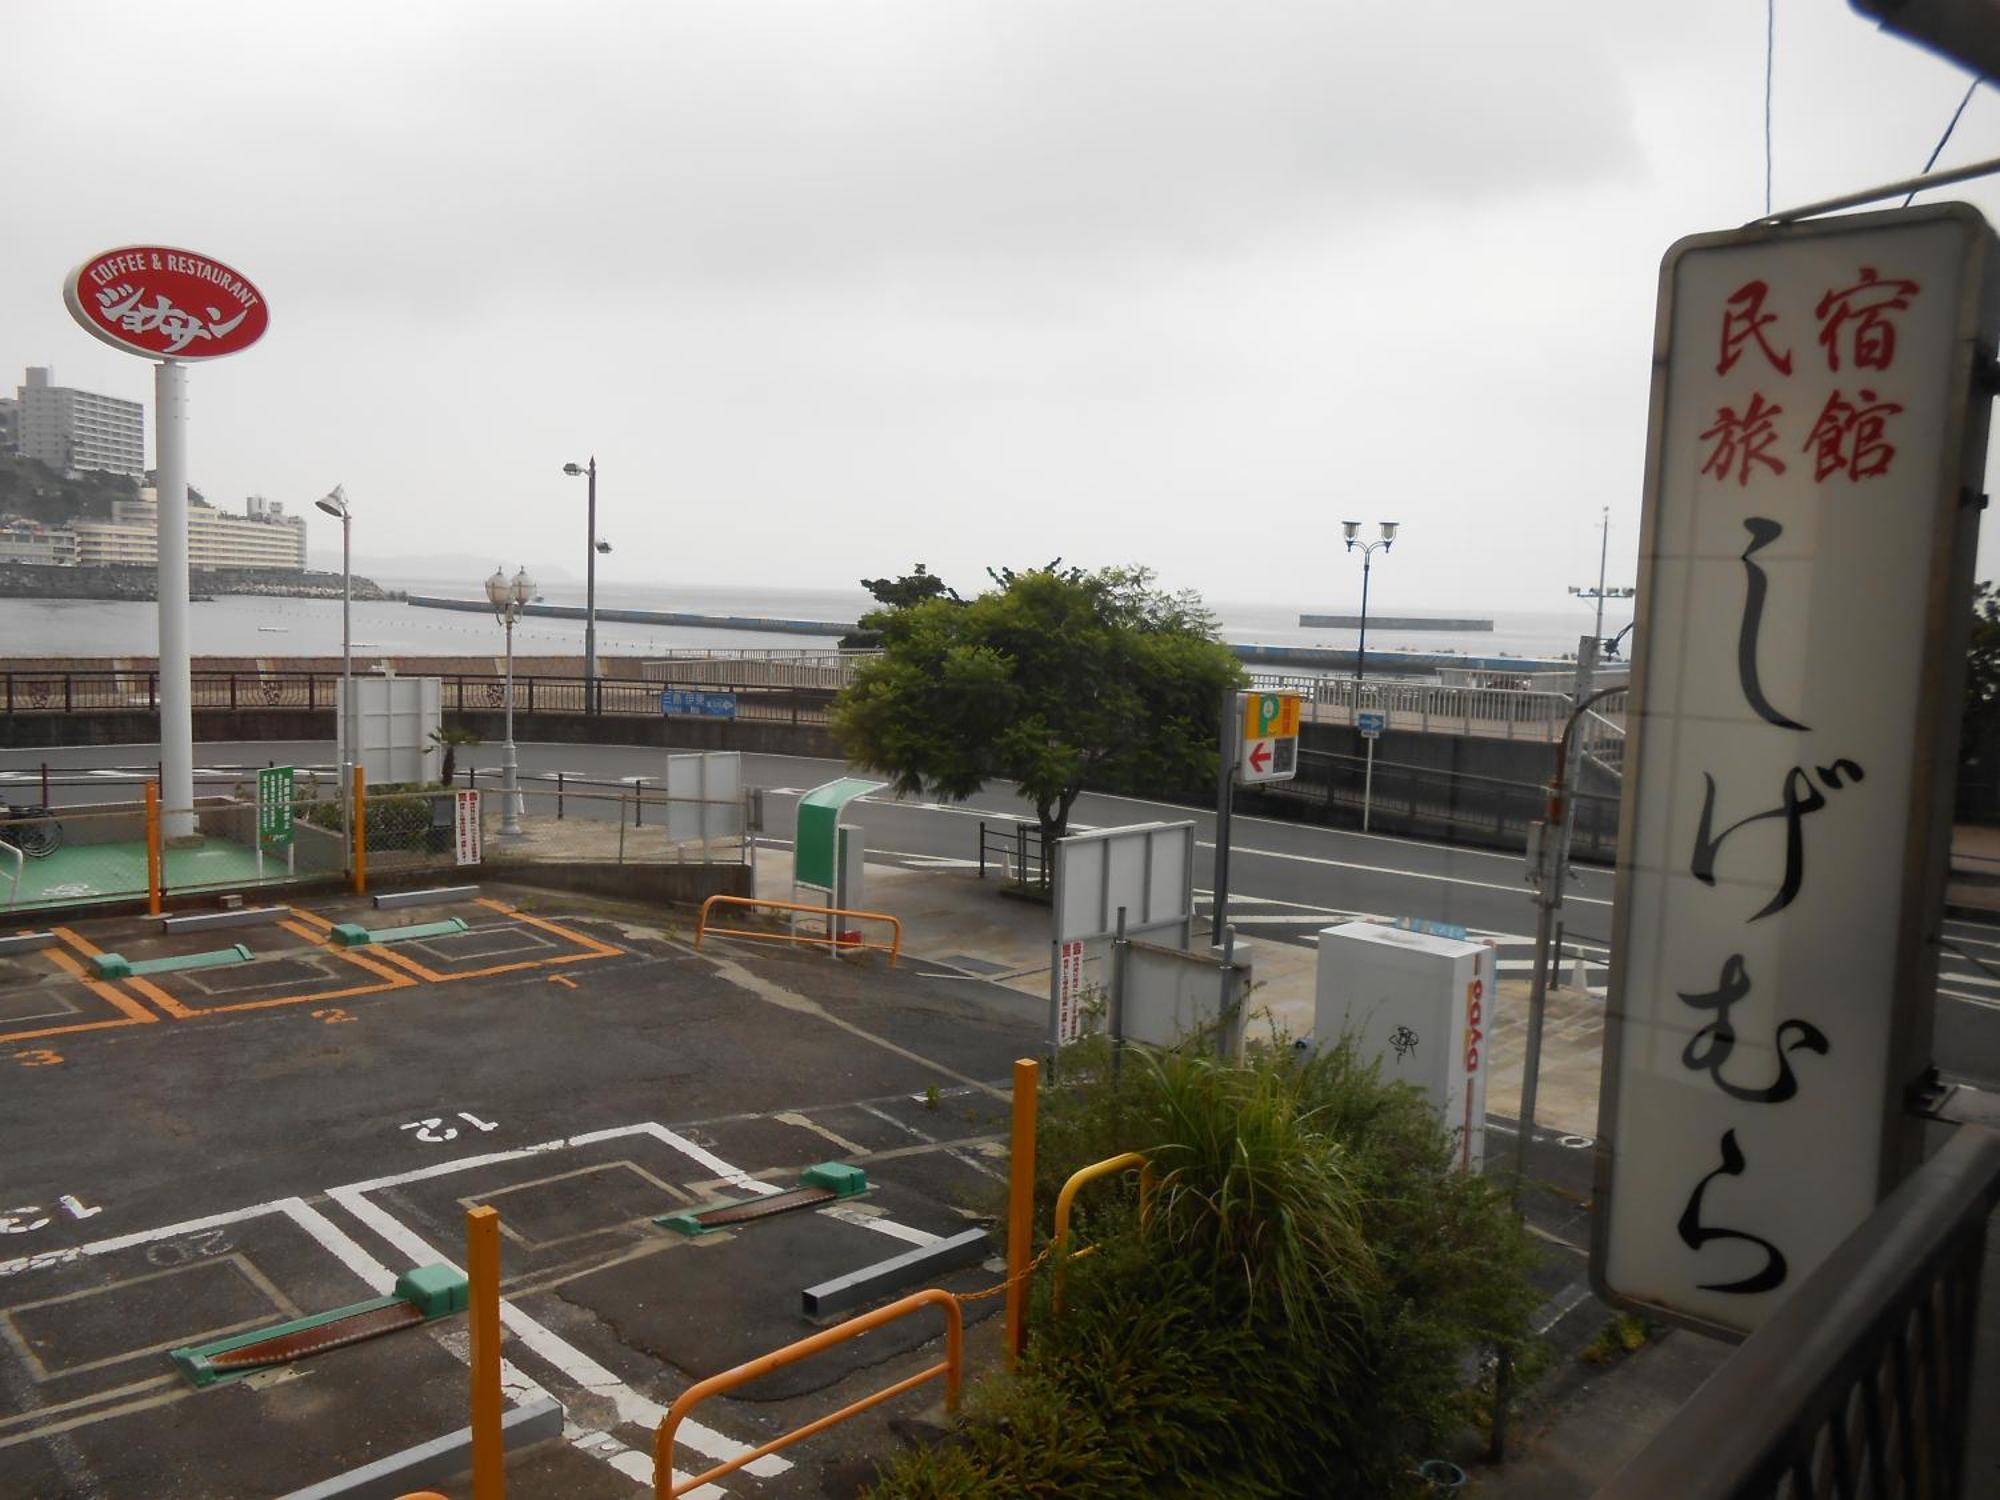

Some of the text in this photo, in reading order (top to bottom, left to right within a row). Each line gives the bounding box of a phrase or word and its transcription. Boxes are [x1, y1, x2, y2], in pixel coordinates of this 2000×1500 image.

[90, 253, 259, 308] COFFEE & RESTAURANT
[95, 283, 248, 352] ジョナサン
[1715, 266, 1920, 377] 民宿
[1699, 389, 1905, 487] 旅館
[1676, 515, 1866, 1296] しげむら
[312, 1008, 359, 1025] 2
[13, 1049, 65, 1067] 3
[401, 1111, 499, 1142] 12
